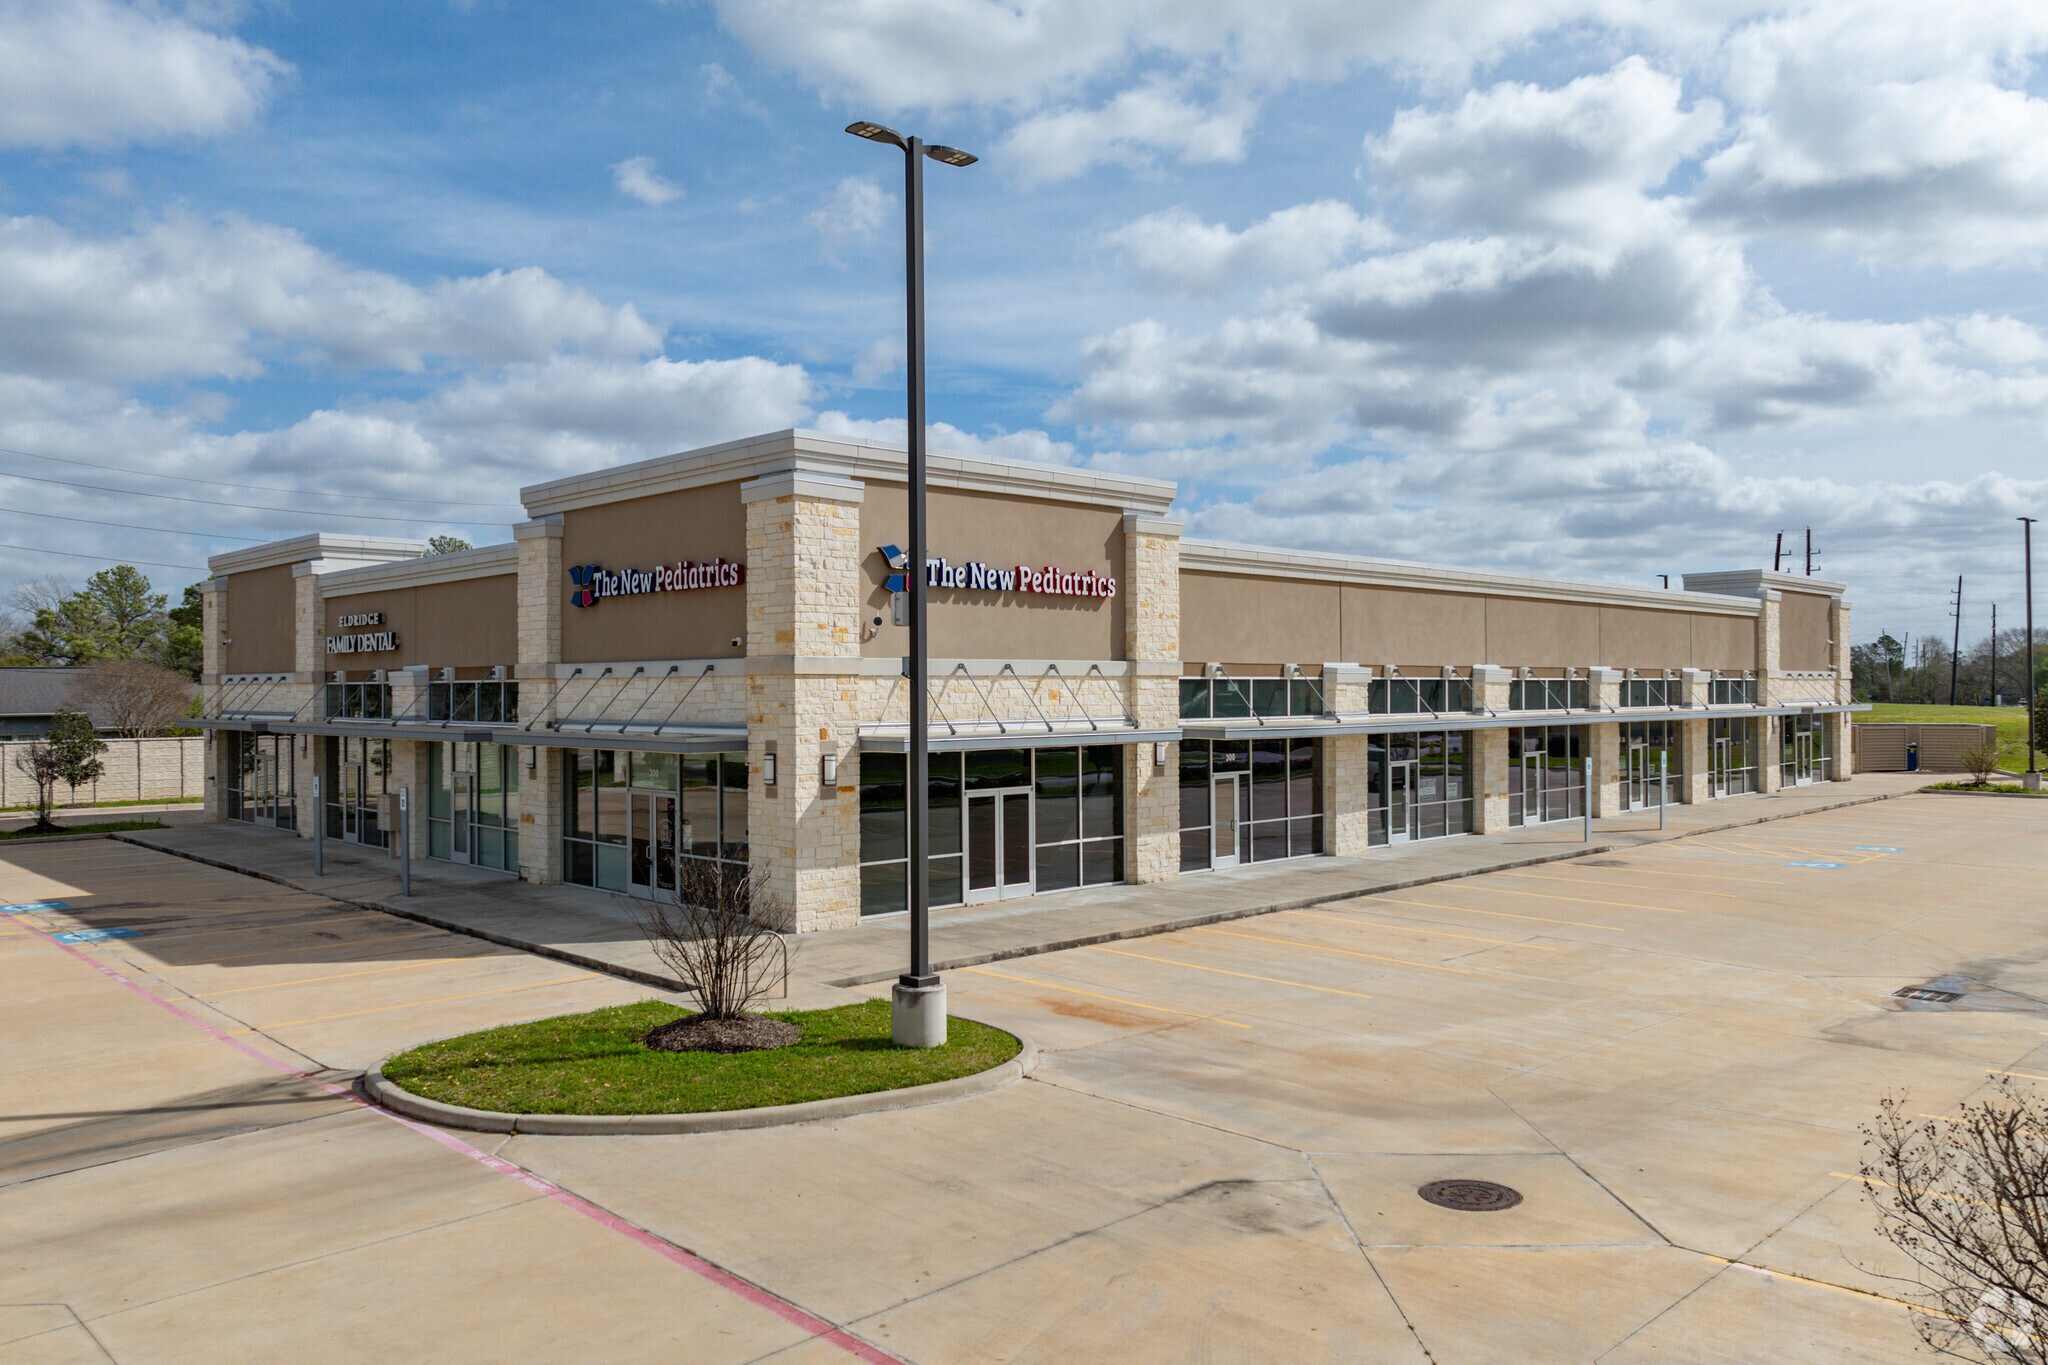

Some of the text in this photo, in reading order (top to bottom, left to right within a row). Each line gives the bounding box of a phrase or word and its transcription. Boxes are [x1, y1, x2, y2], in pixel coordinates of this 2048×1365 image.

[593, 557, 738, 597] The New Pediatrics
[926, 558, 1116, 597] The New Pediatrics
[339, 613, 379, 627] ELDRIDGE
[326, 631, 396, 654] FAMILY DENTAL
